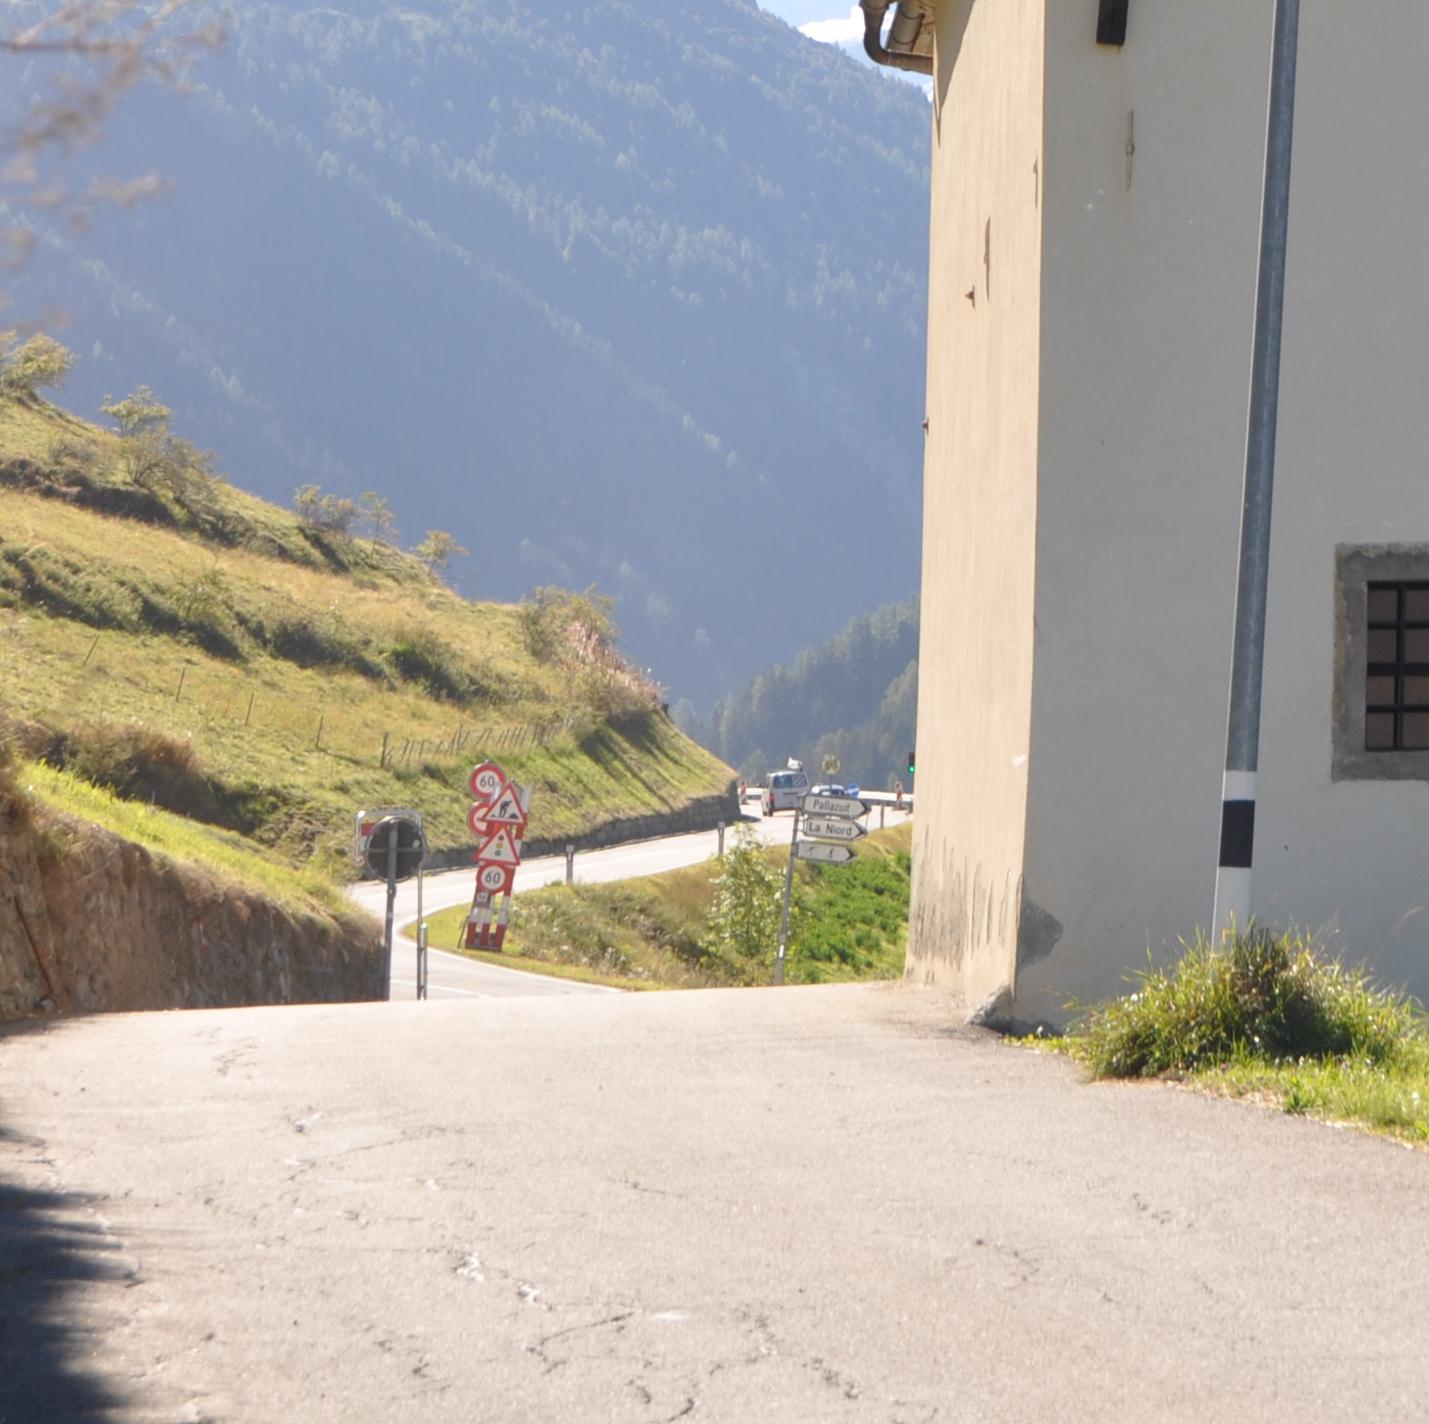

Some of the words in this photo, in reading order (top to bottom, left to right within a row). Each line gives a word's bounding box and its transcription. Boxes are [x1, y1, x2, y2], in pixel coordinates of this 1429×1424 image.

[480, 776, 495, 788] 60
[809, 822, 821, 832] La
[825, 824, 852, 836] Niord
[485, 871, 501, 884] 60
